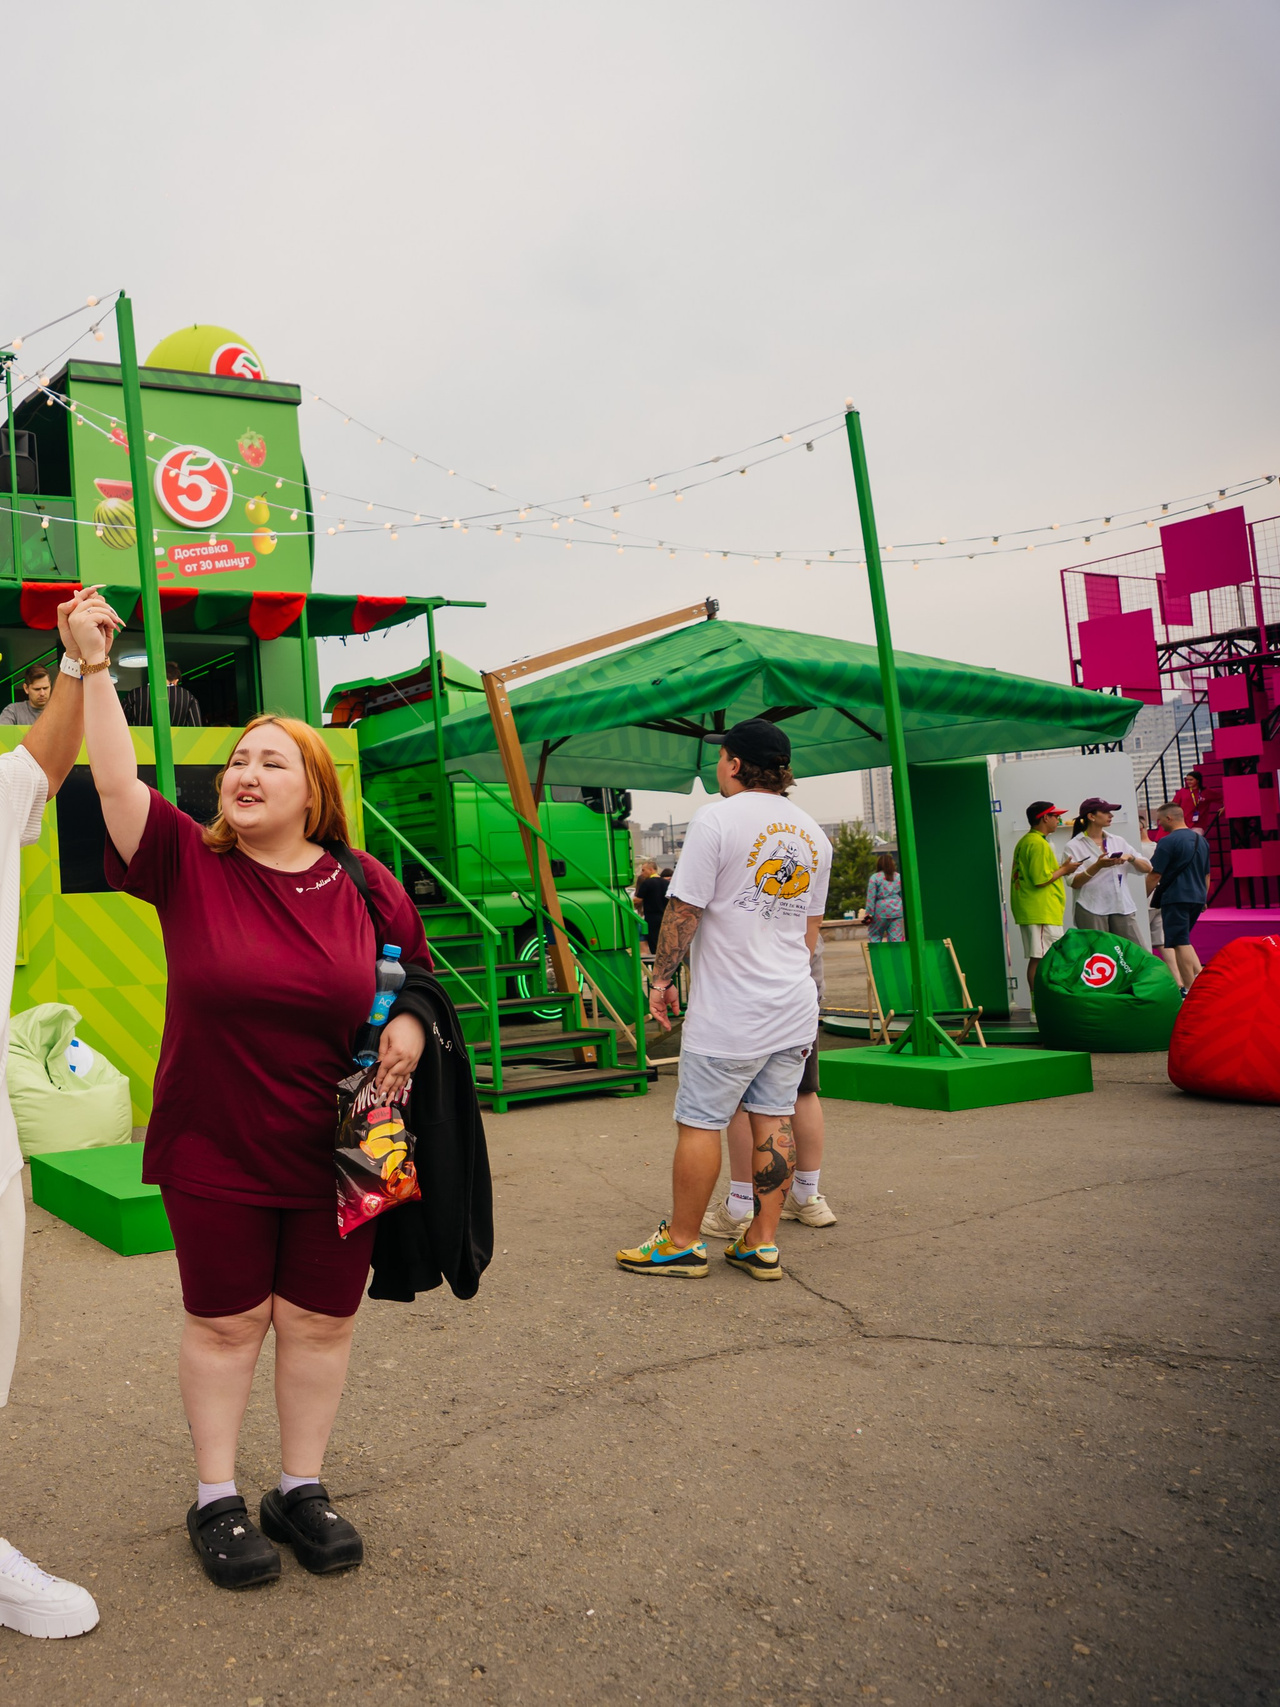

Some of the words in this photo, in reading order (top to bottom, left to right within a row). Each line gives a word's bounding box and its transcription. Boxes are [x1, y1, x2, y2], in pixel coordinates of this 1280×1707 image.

[177, 451, 215, 512] 5
[174, 543, 228, 560] Доставка
[184, 563, 198, 573] от
[200, 559, 213, 571] 30
[215, 556, 251, 568] минут
[746, 832, 768, 868] VANS
[766, 822, 797, 835] GREAT
[799, 828, 819, 874] ESCAPE
